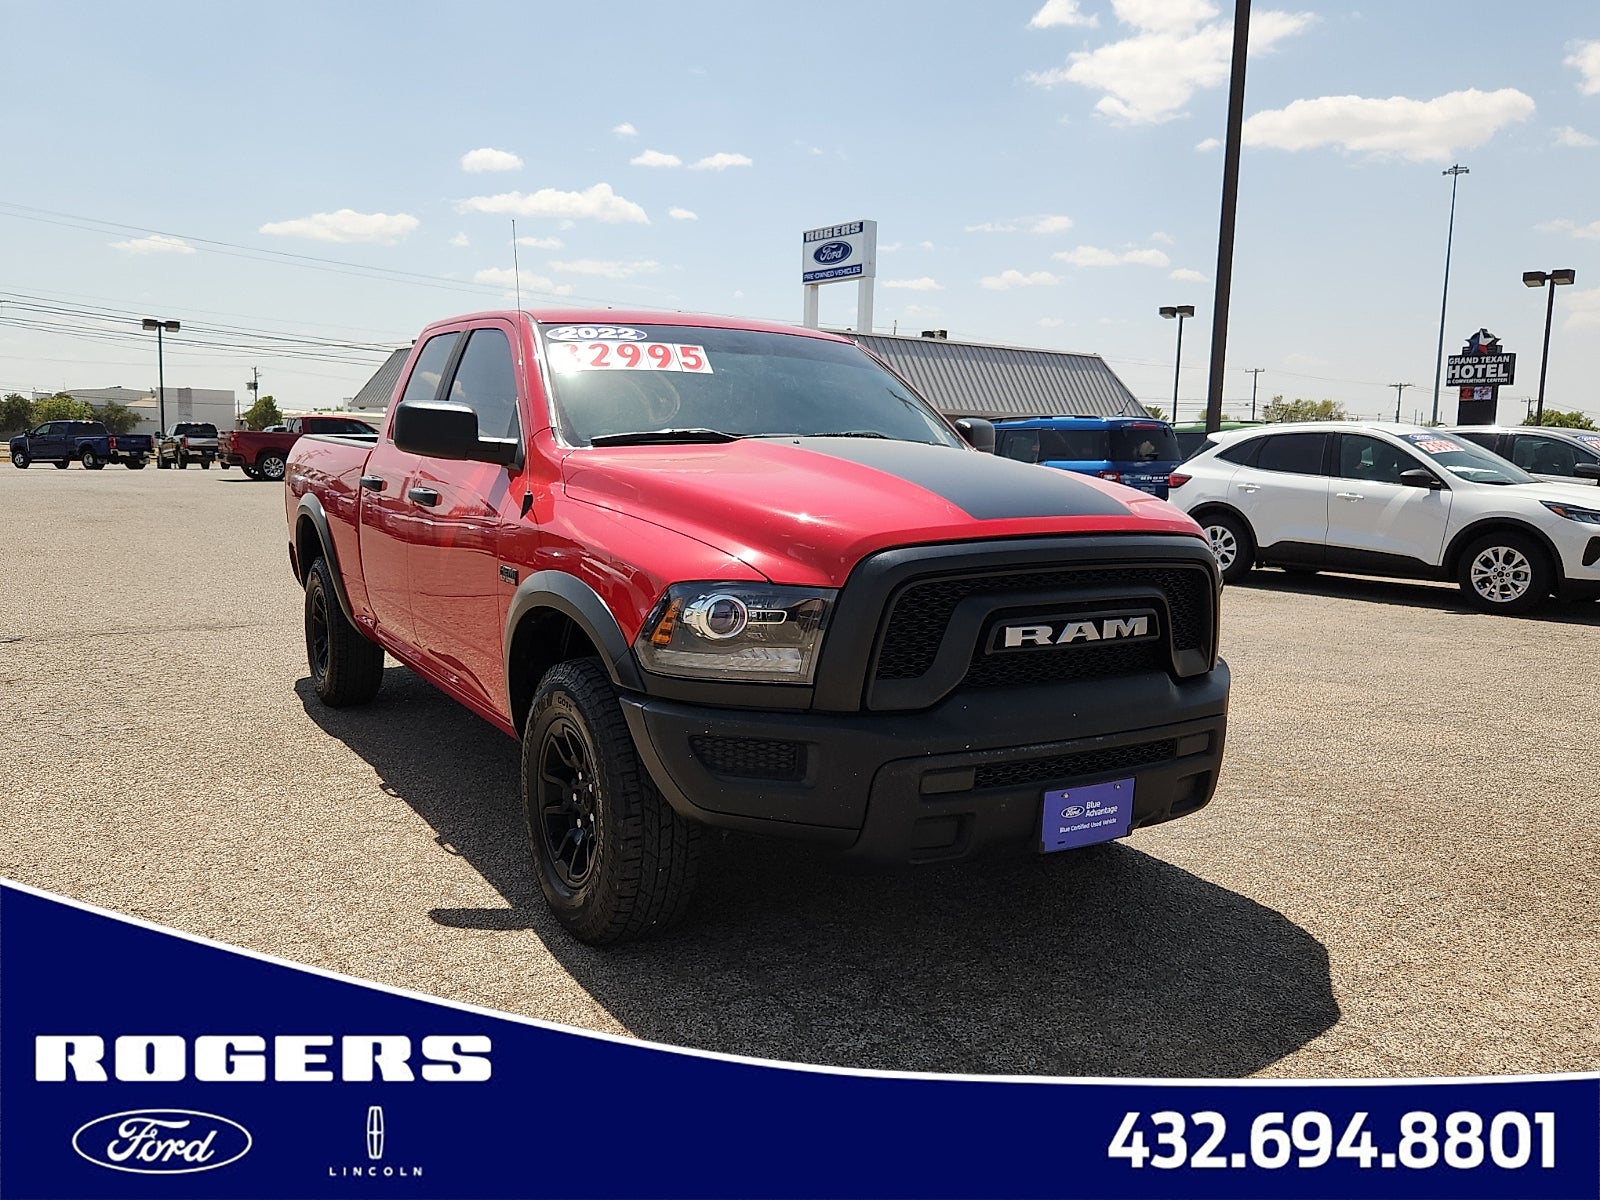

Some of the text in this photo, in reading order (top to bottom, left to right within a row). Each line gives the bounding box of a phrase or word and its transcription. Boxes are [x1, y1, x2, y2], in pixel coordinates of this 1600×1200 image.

[805, 223, 861, 241] ROGERS
[820, 244, 844, 261] Ford
[804, 266, 861, 280] PRE-OWNED VEHICLES
[557, 327, 638, 339] 2022
[1448, 355, 1510, 365] GRAND TEXAN
[1447, 364, 1509, 379] HOTEL
[1004, 616, 1148, 648] RAM
[1085, 805, 1118, 817] Advantage
[1086, 801, 1101, 809] Blue
[1064, 807, 1081, 817] Ford
[1070, 822, 1090, 831] Certified
